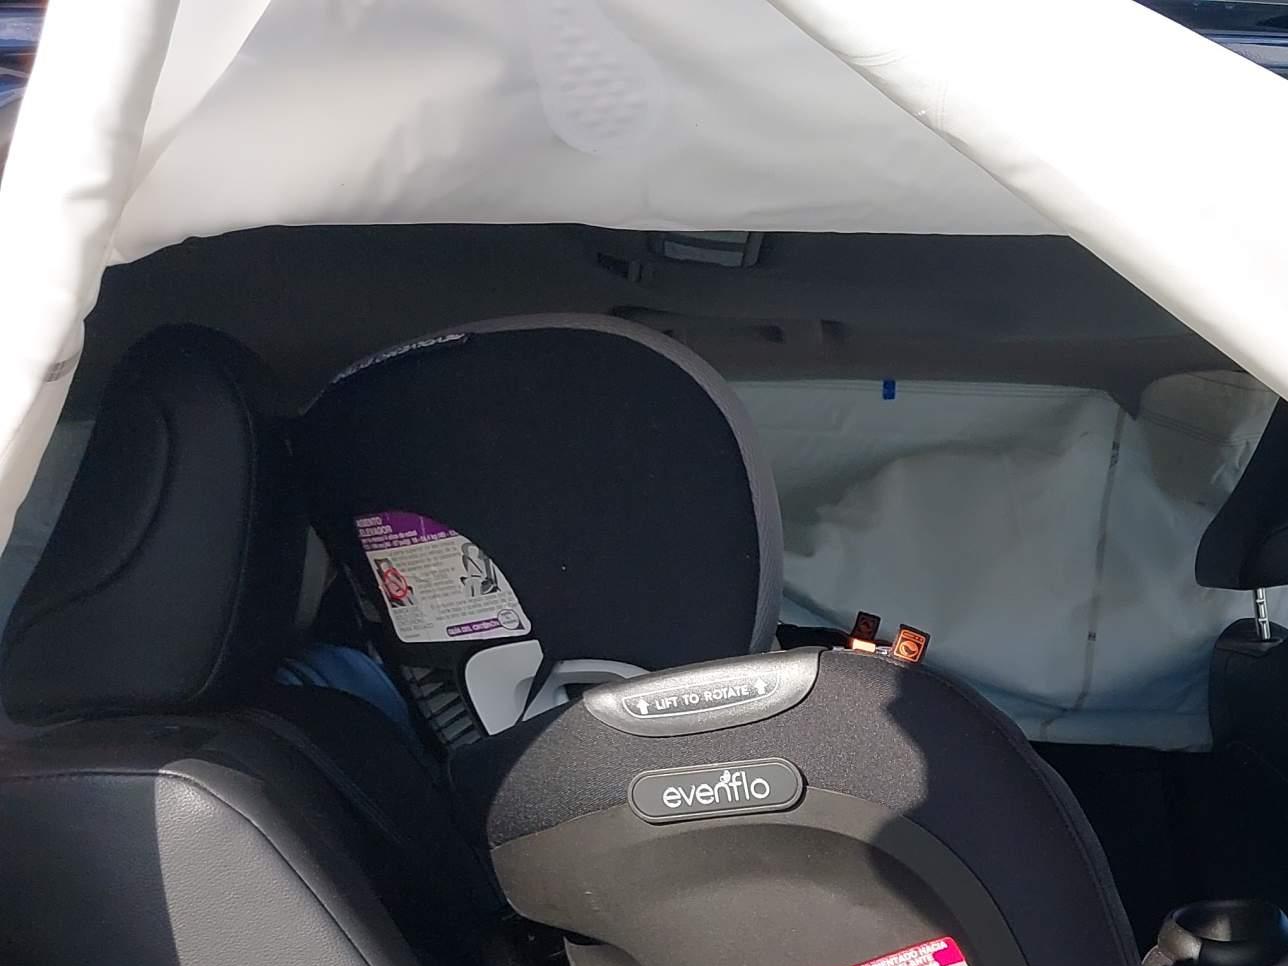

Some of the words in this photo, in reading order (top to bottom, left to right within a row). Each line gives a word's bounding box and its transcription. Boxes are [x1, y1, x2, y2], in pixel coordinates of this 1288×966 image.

[655, 696, 679, 710] LIFT
[682, 693, 700, 706] TO
[704, 685, 751, 702] ROTATE
[662, 770, 770, 808] evenflo
[920, 941, 948, 956] HACIA
